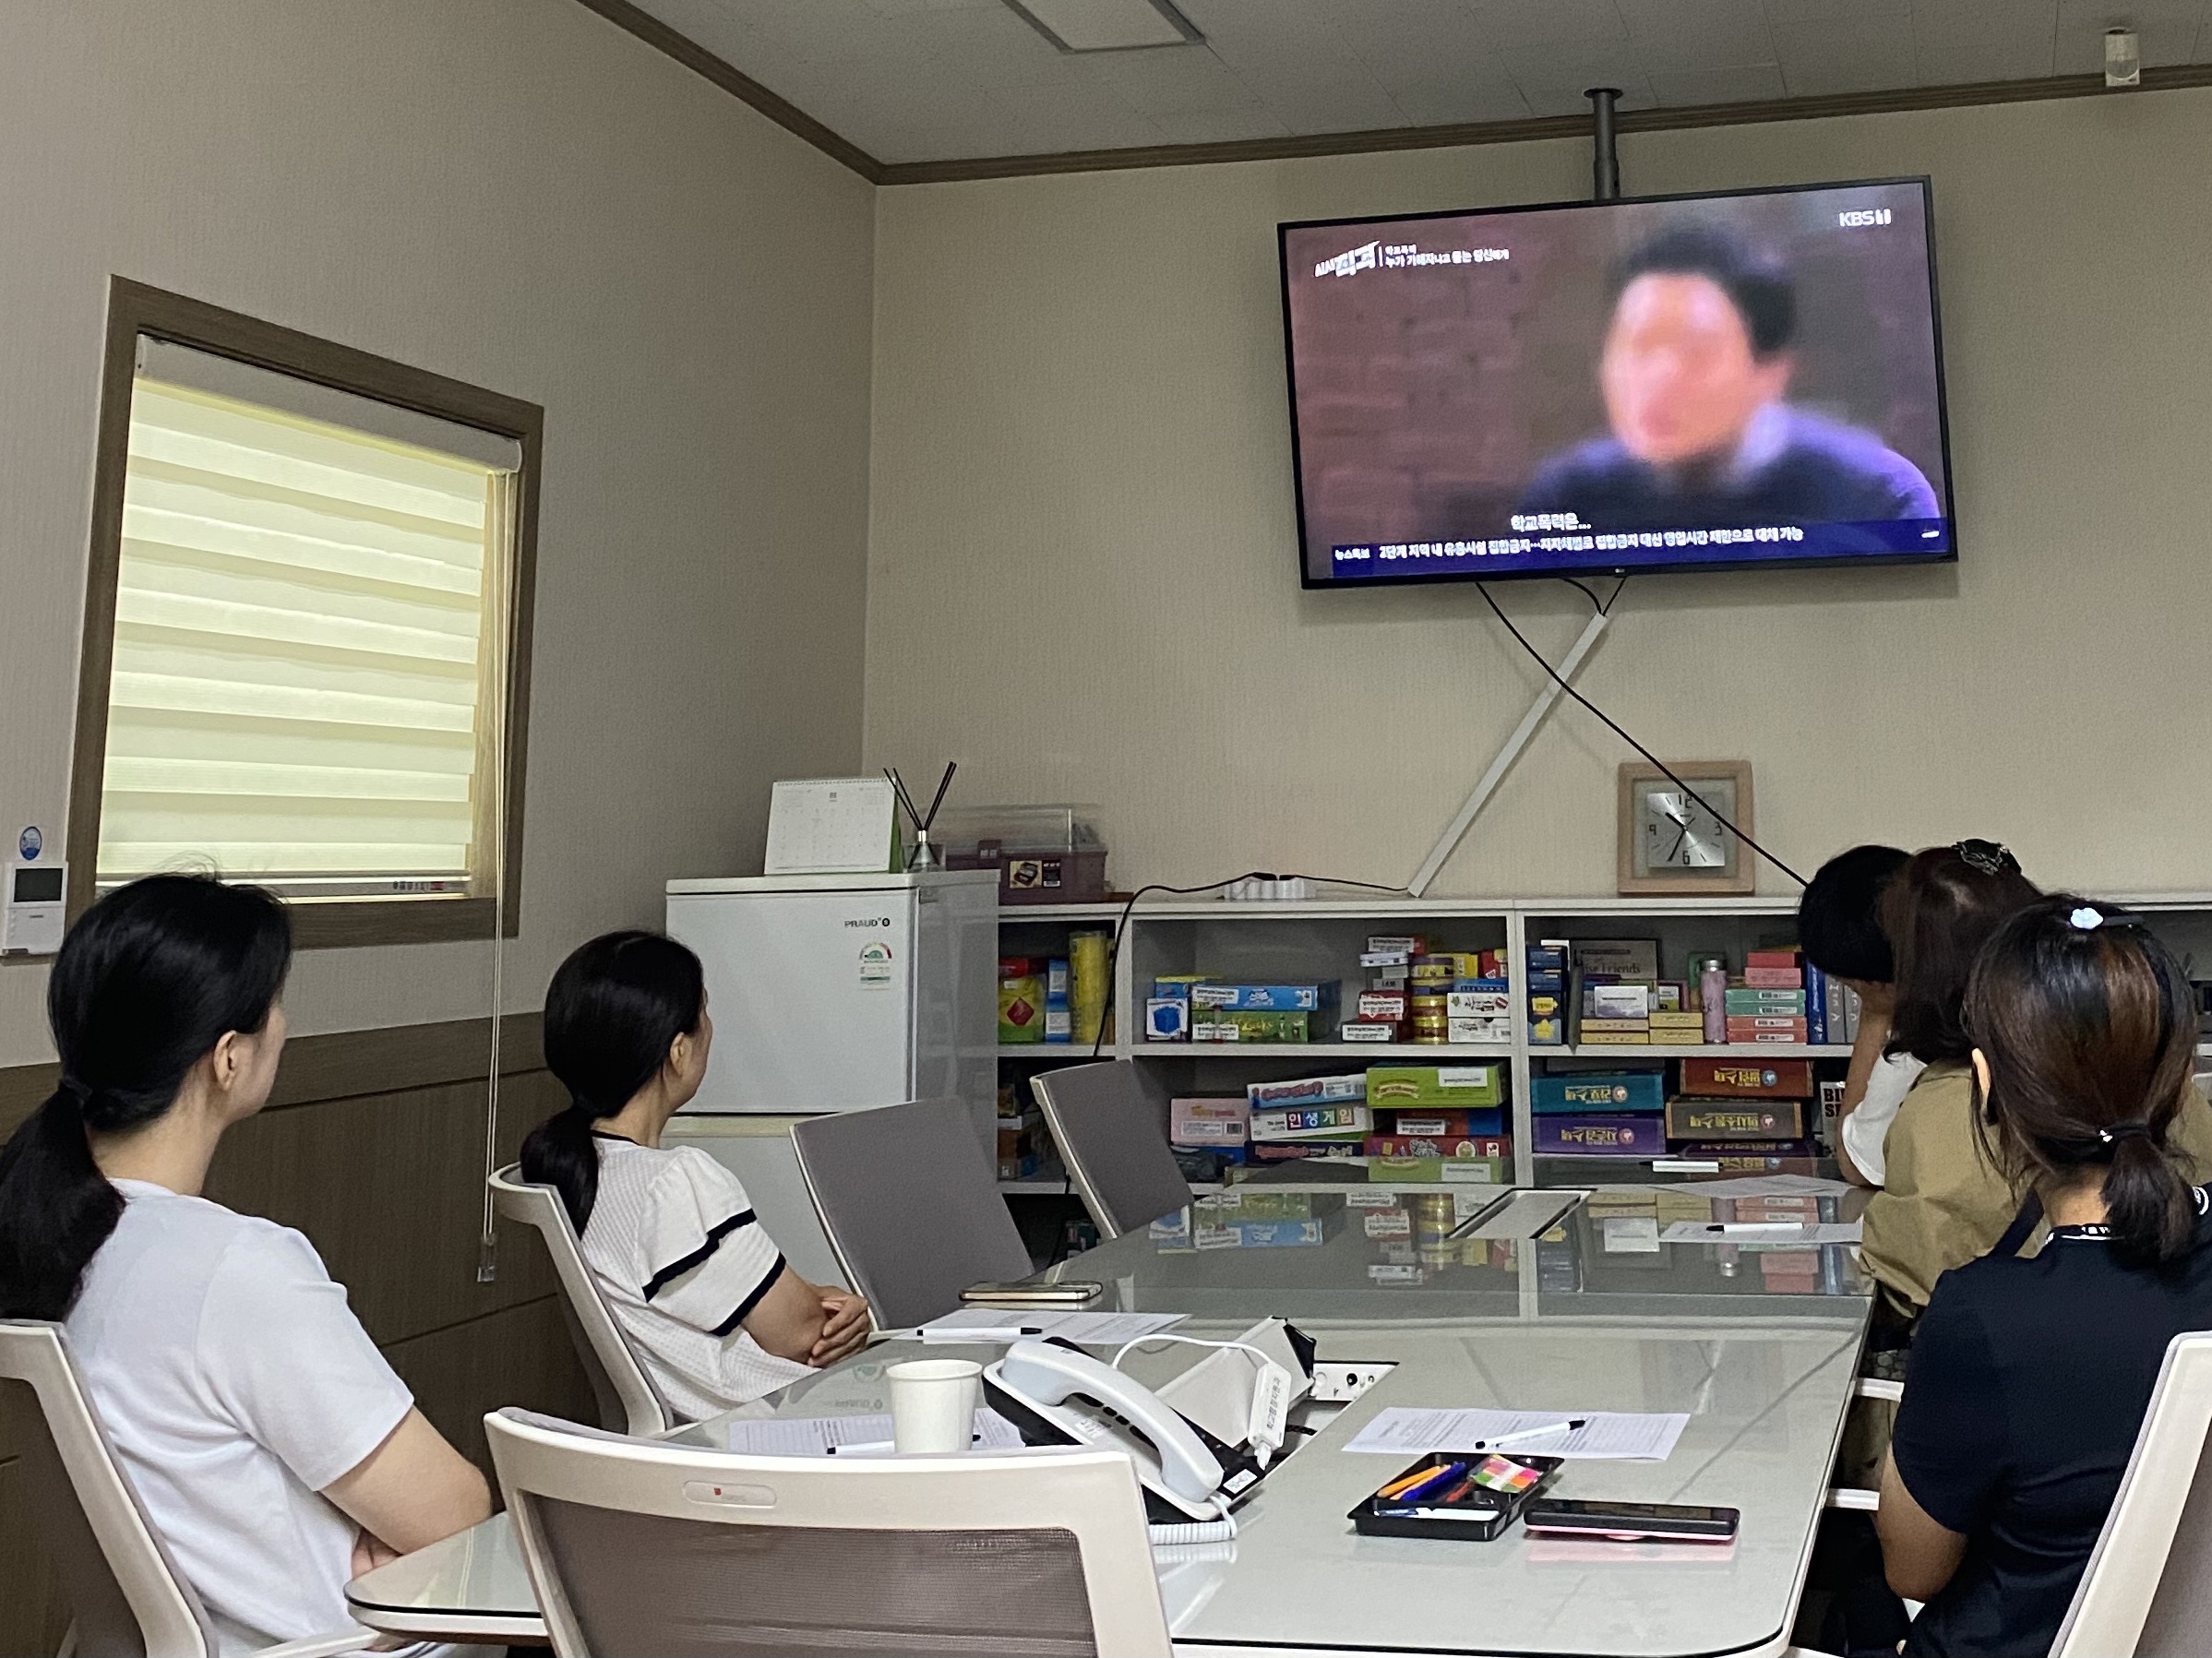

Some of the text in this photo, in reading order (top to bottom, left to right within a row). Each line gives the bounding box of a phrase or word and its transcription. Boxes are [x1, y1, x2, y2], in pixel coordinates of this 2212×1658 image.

[1408, 543, 1430, 558] 지역
[1640, 531, 1663, 547] 대신
[1779, 526, 1804, 542] 가능
[1682, 851, 1691, 865] 6
[1289, 1109, 1353, 1128] 인생게임
